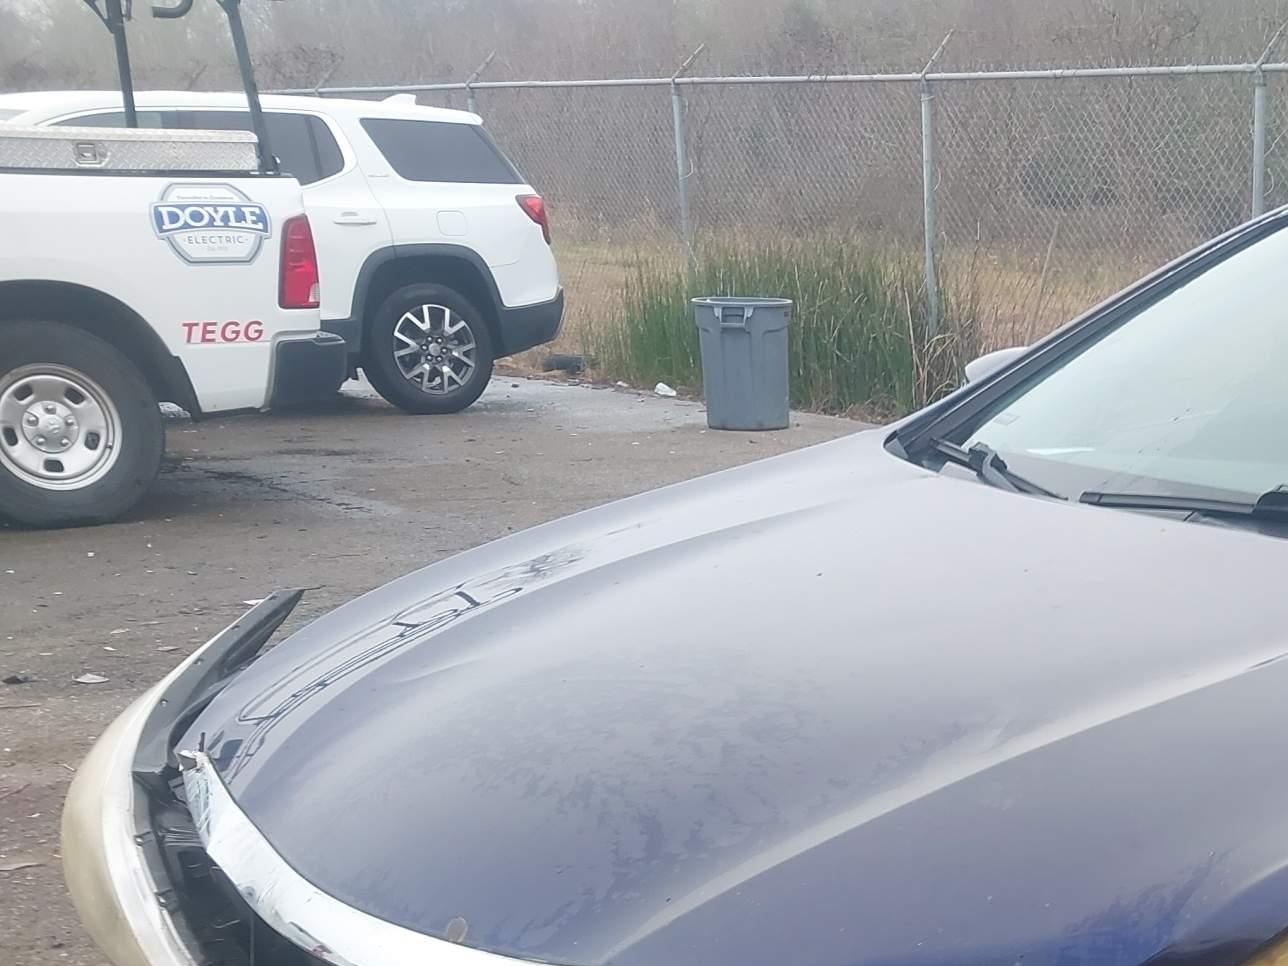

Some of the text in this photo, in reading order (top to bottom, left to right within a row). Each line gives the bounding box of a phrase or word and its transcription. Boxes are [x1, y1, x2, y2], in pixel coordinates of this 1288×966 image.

[158, 206, 264, 230] DOYLE
[187, 235, 245, 244] ELECTRIC
[182, 320, 264, 343] TEGG
